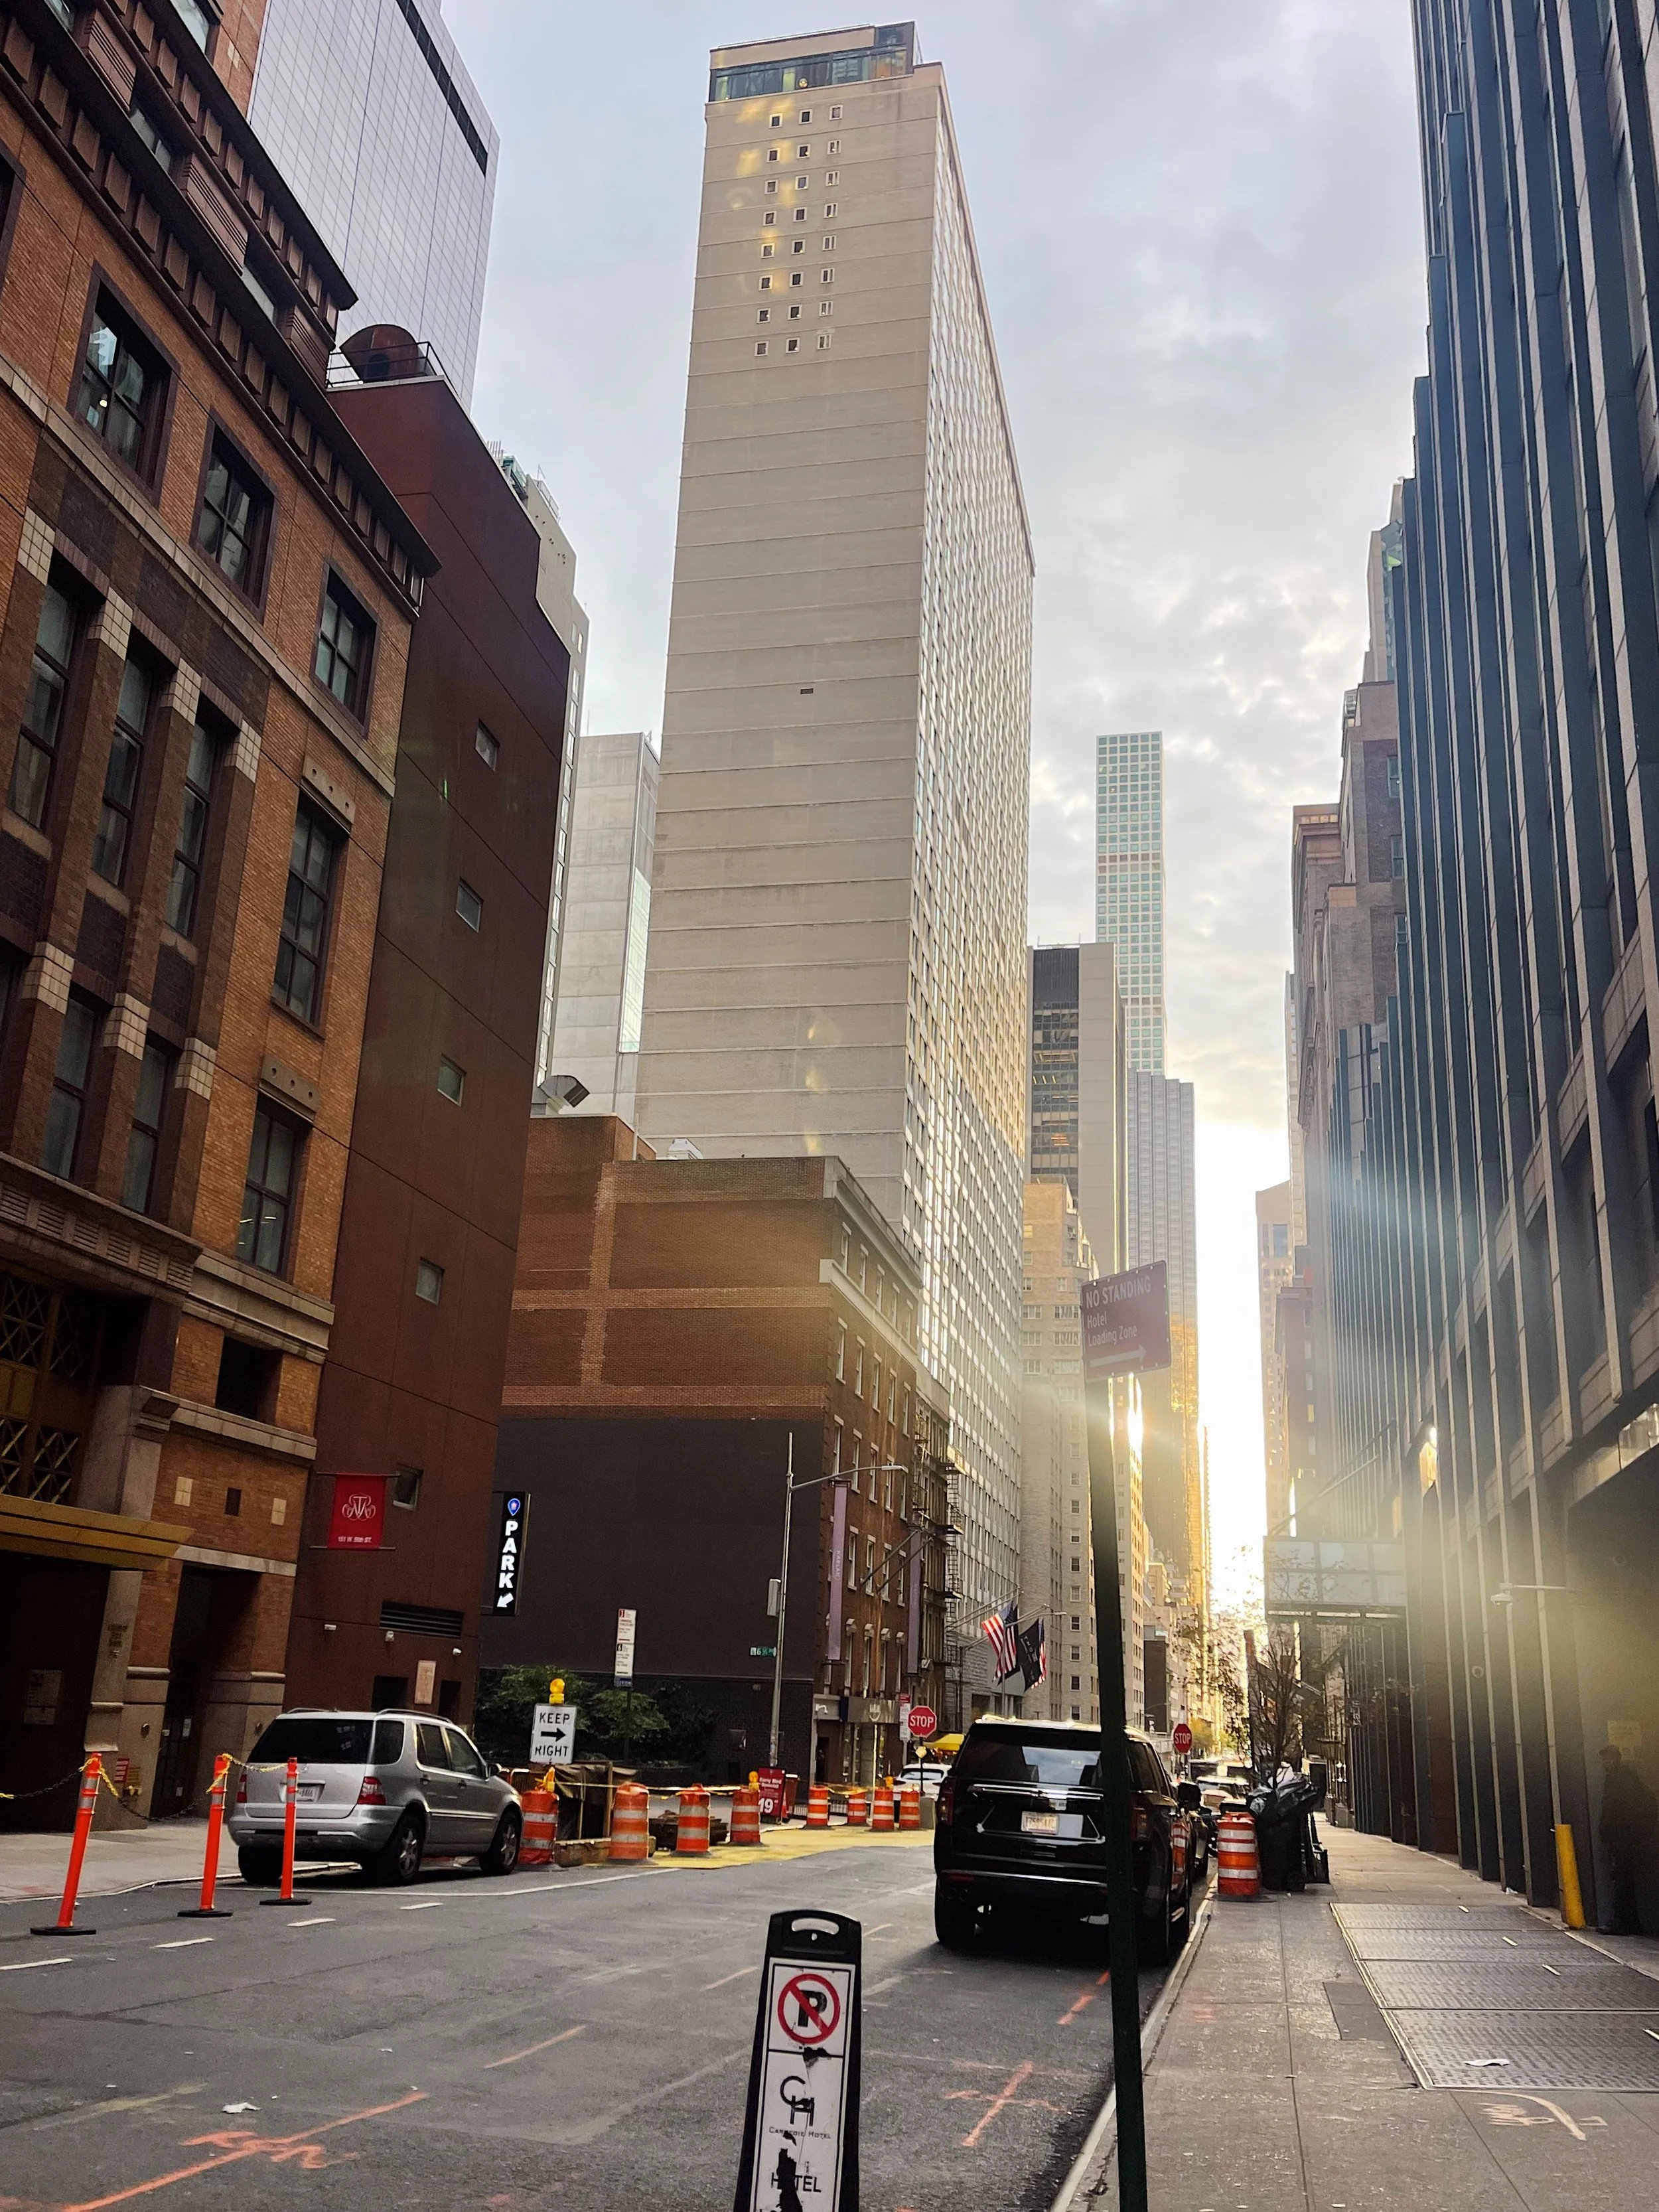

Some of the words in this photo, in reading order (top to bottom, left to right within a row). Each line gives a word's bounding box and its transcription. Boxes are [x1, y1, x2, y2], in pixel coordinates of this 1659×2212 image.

[1086, 1290, 1100, 1309] NO
[1102, 1276, 1151, 1305] STANDING
[1087, 1311, 1108, 1329] Hotel
[1088, 1329, 1117, 1347] Loading
[1118, 1325, 1138, 1341] Zone
[499, 1520, 518, 1588] PARK
[540, 1712, 570, 1724] KEEP
[909, 1716, 934, 1728] STOP
[1175, 1733, 1191, 1744] STOP
[535, 1745, 569, 1757] RIGHT
[770, 2172, 822, 2193] HTEL
